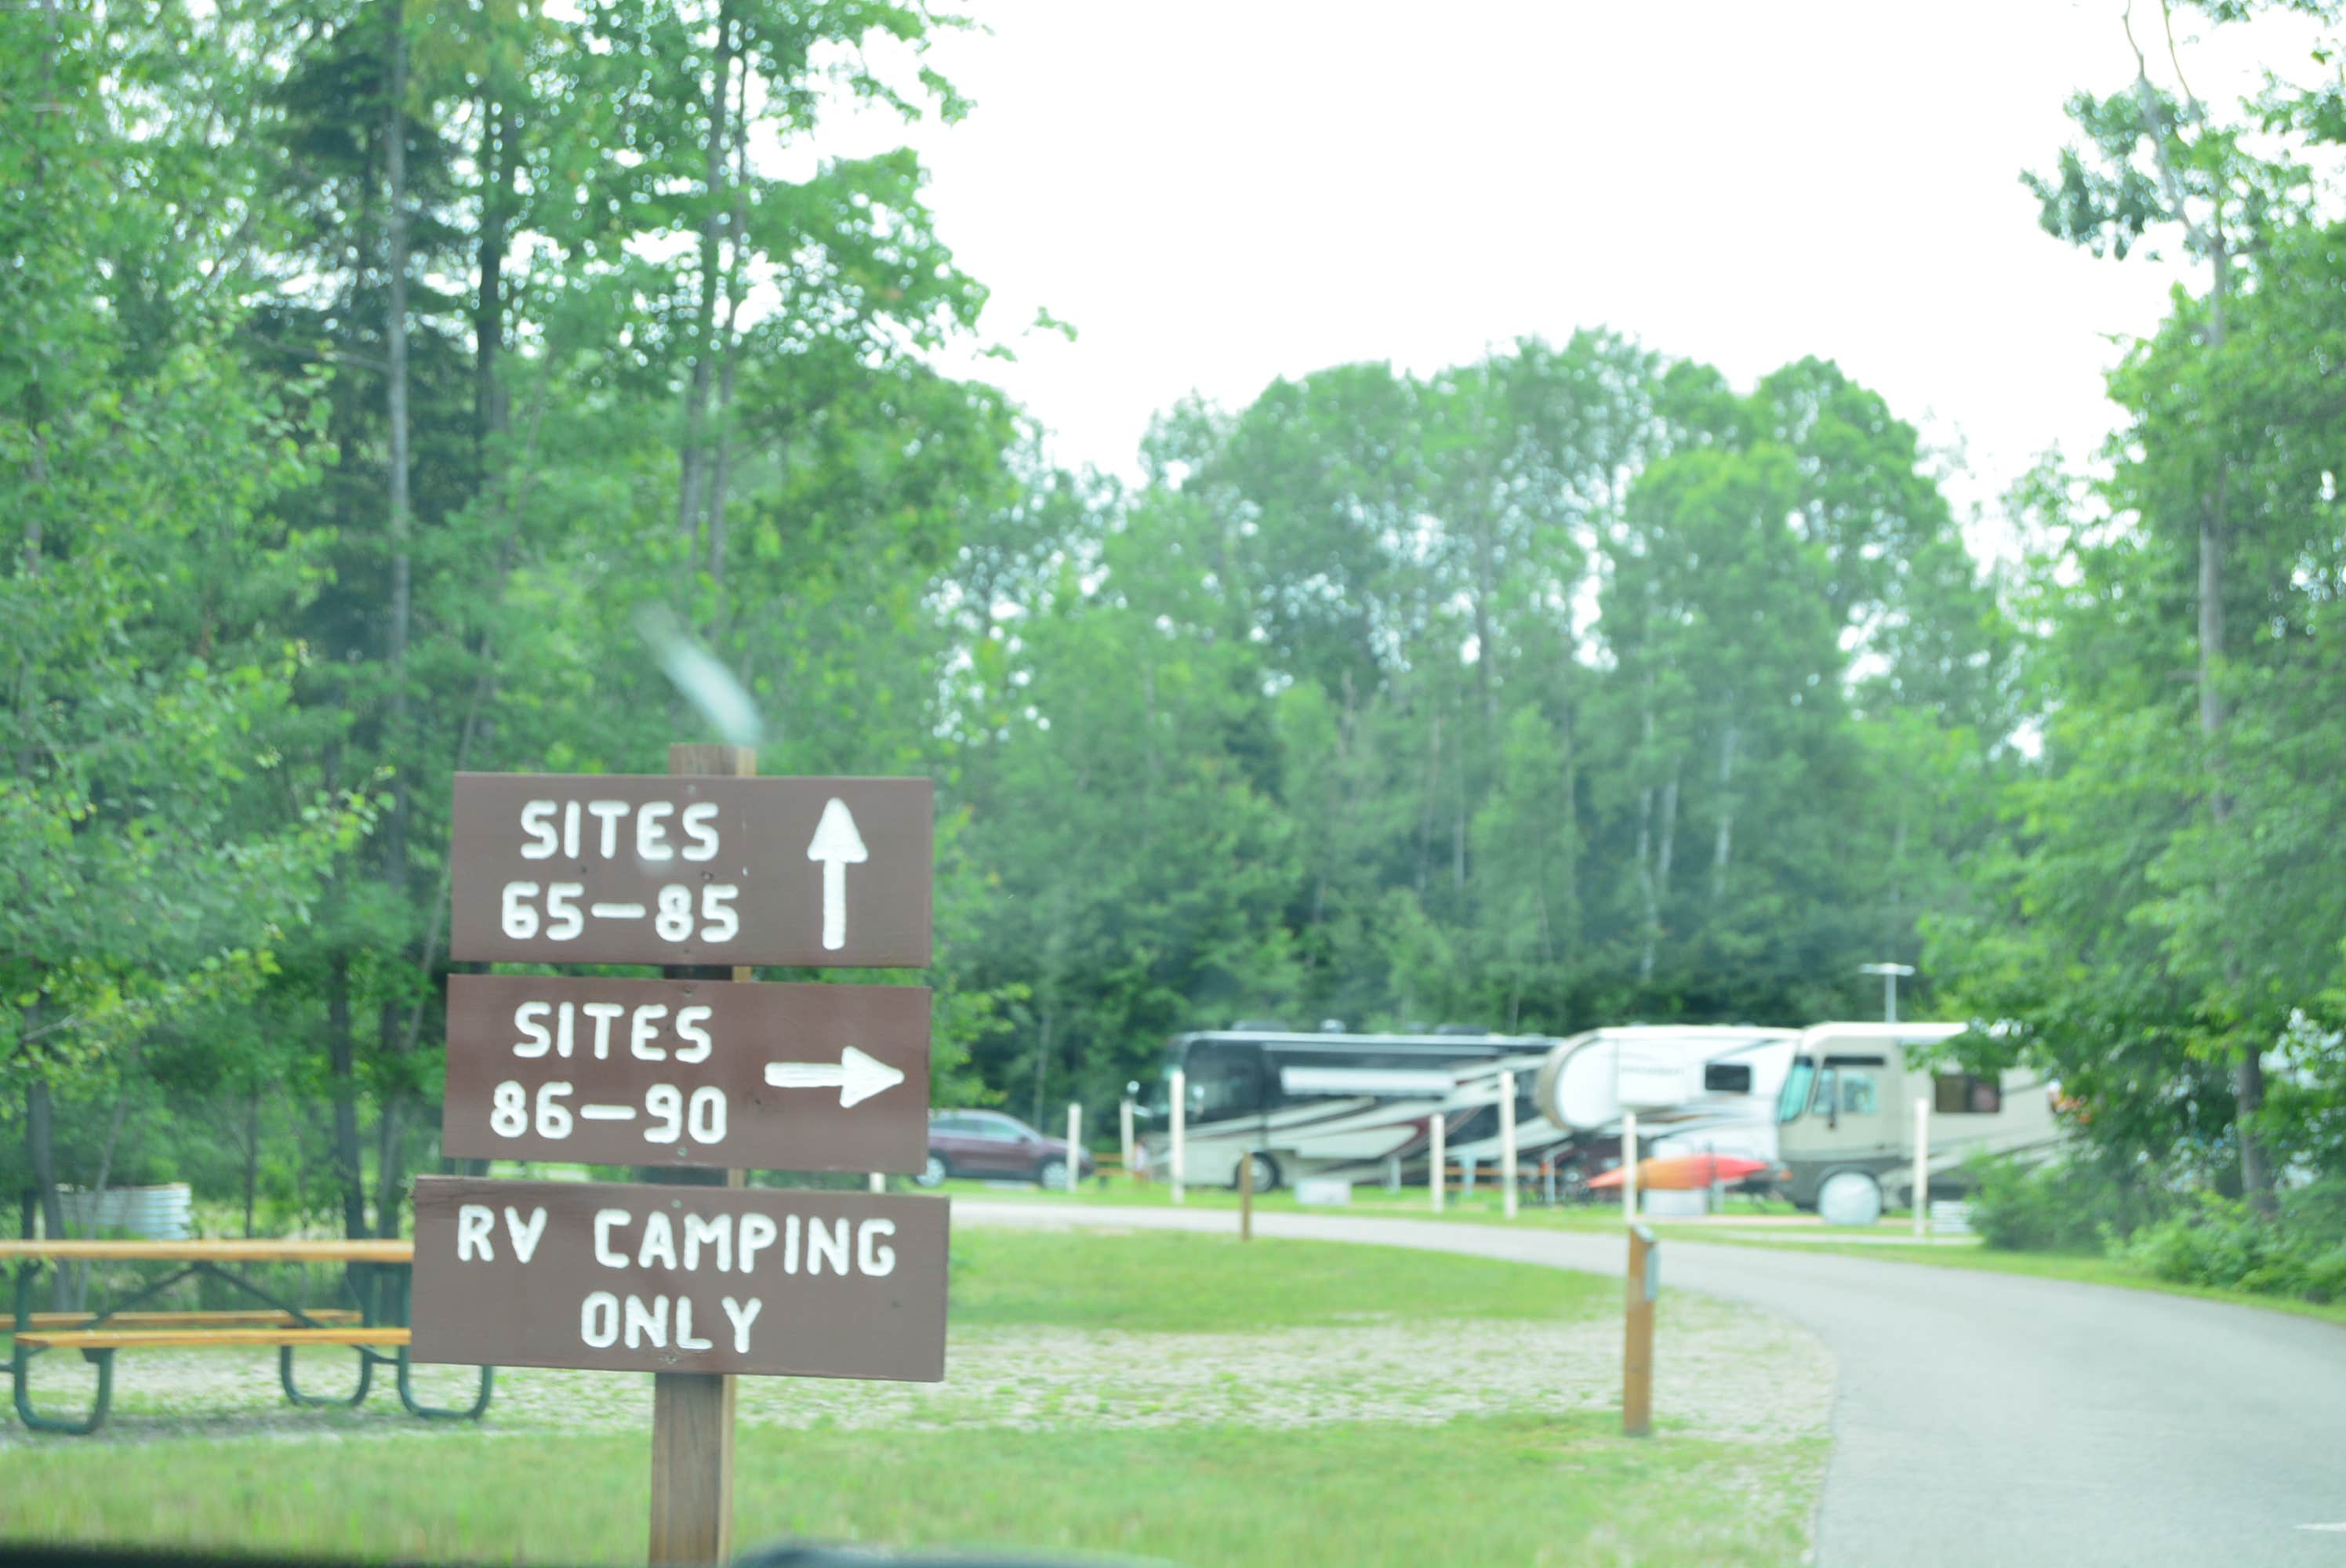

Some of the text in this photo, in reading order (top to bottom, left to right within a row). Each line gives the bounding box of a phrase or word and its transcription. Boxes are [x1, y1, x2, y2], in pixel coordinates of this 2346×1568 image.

[519, 800, 720, 862] SITES
[512, 1001, 713, 1064] SITES
[456, 1204, 896, 1278] RV CAMPING
[580, 1290, 763, 1355] ONLY
